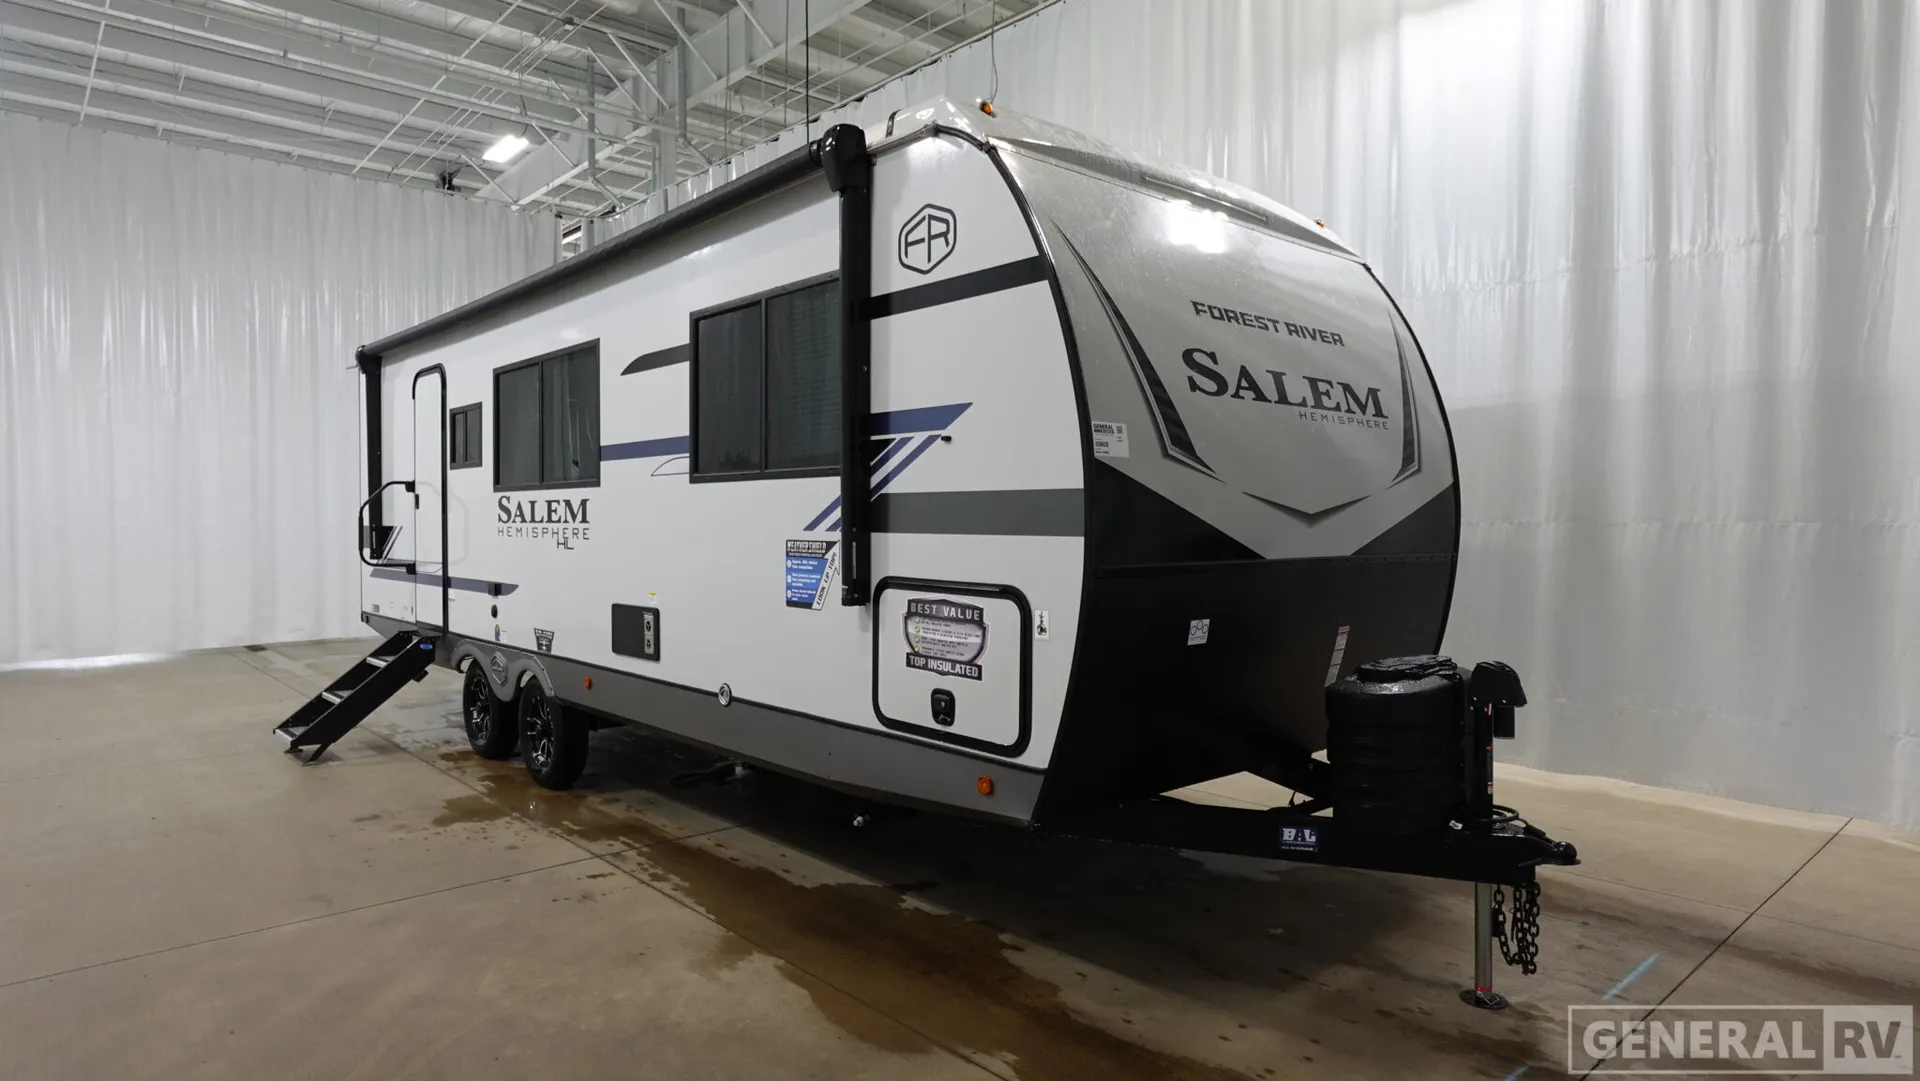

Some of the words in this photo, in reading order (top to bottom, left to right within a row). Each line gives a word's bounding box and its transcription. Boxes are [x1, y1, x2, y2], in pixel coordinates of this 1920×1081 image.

[1190, 300, 1280, 334] FOREST
[1284, 321, 1345, 347] RIVER
[1181, 347, 1389, 419] SALEM
[1299, 410, 1389, 431] HEMISPHERE
[497, 495, 590, 524] SALEM
[497, 526, 590, 540] HEMISPHERE
[557, 537, 575, 550] HL
[816, 586, 826, 606] LOOK
[823, 572, 830, 584] UP
[910, 602, 938, 615] BEST
[943, 606, 981, 621] VALUE
[909, 655, 926, 667] TOP
[927, 659, 979, 677] INSULATED
